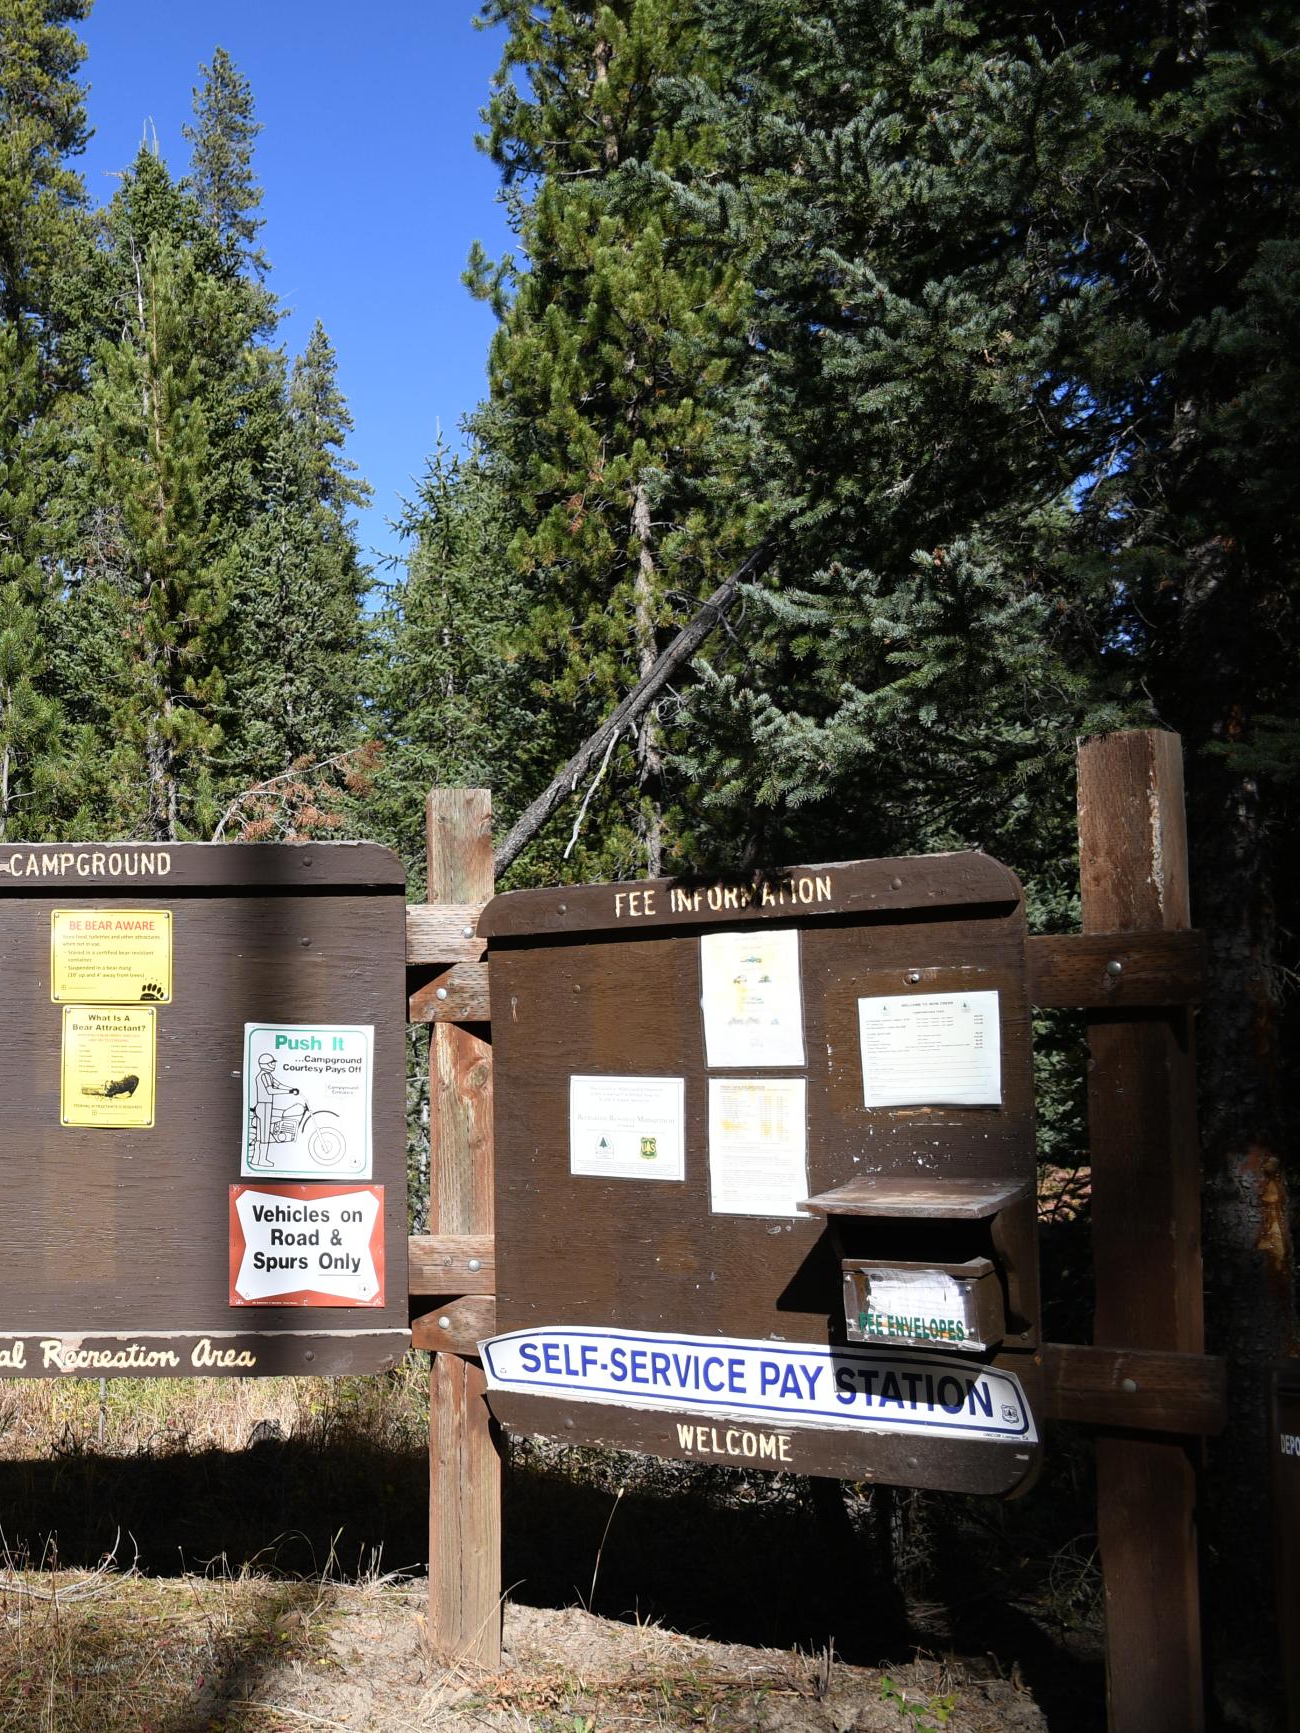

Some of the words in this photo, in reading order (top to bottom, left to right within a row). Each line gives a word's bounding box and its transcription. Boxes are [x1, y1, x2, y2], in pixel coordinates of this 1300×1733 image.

[10, 852, 171, 876] CAMPGROUND
[615, 890, 656, 918] FEE
[69, 920, 82, 930] BE
[85, 920, 112, 930] BEAR
[115, 920, 155, 930] AWARE
[276, 1035, 322, 1050] Push
[332, 1036, 344, 1051] It
[283, 1064, 323, 1073] Courtesy
[325, 1066, 346, 1074] Pays
[252, 1205, 330, 1223] Vehicles
[340, 1210, 363, 1222] on
[271, 1228, 320, 1246] Road
[330, 1229, 342, 1246] &
[254, 1252, 308, 1272] Spurs
[318, 1252, 361, 1273] Only
[859, 1312, 884, 1336] FEE
[887, 1314, 965, 1341] ENVELOPES
[40, 1340, 180, 1368] Recreation
[191, 1339, 256, 1368] Area
[519, 1342, 746, 1394] SELF-SERVICE
[760, 1361, 823, 1400] PAY
[836, 1366, 993, 1418] STATION
[677, 1424, 793, 1461] WELCOME
